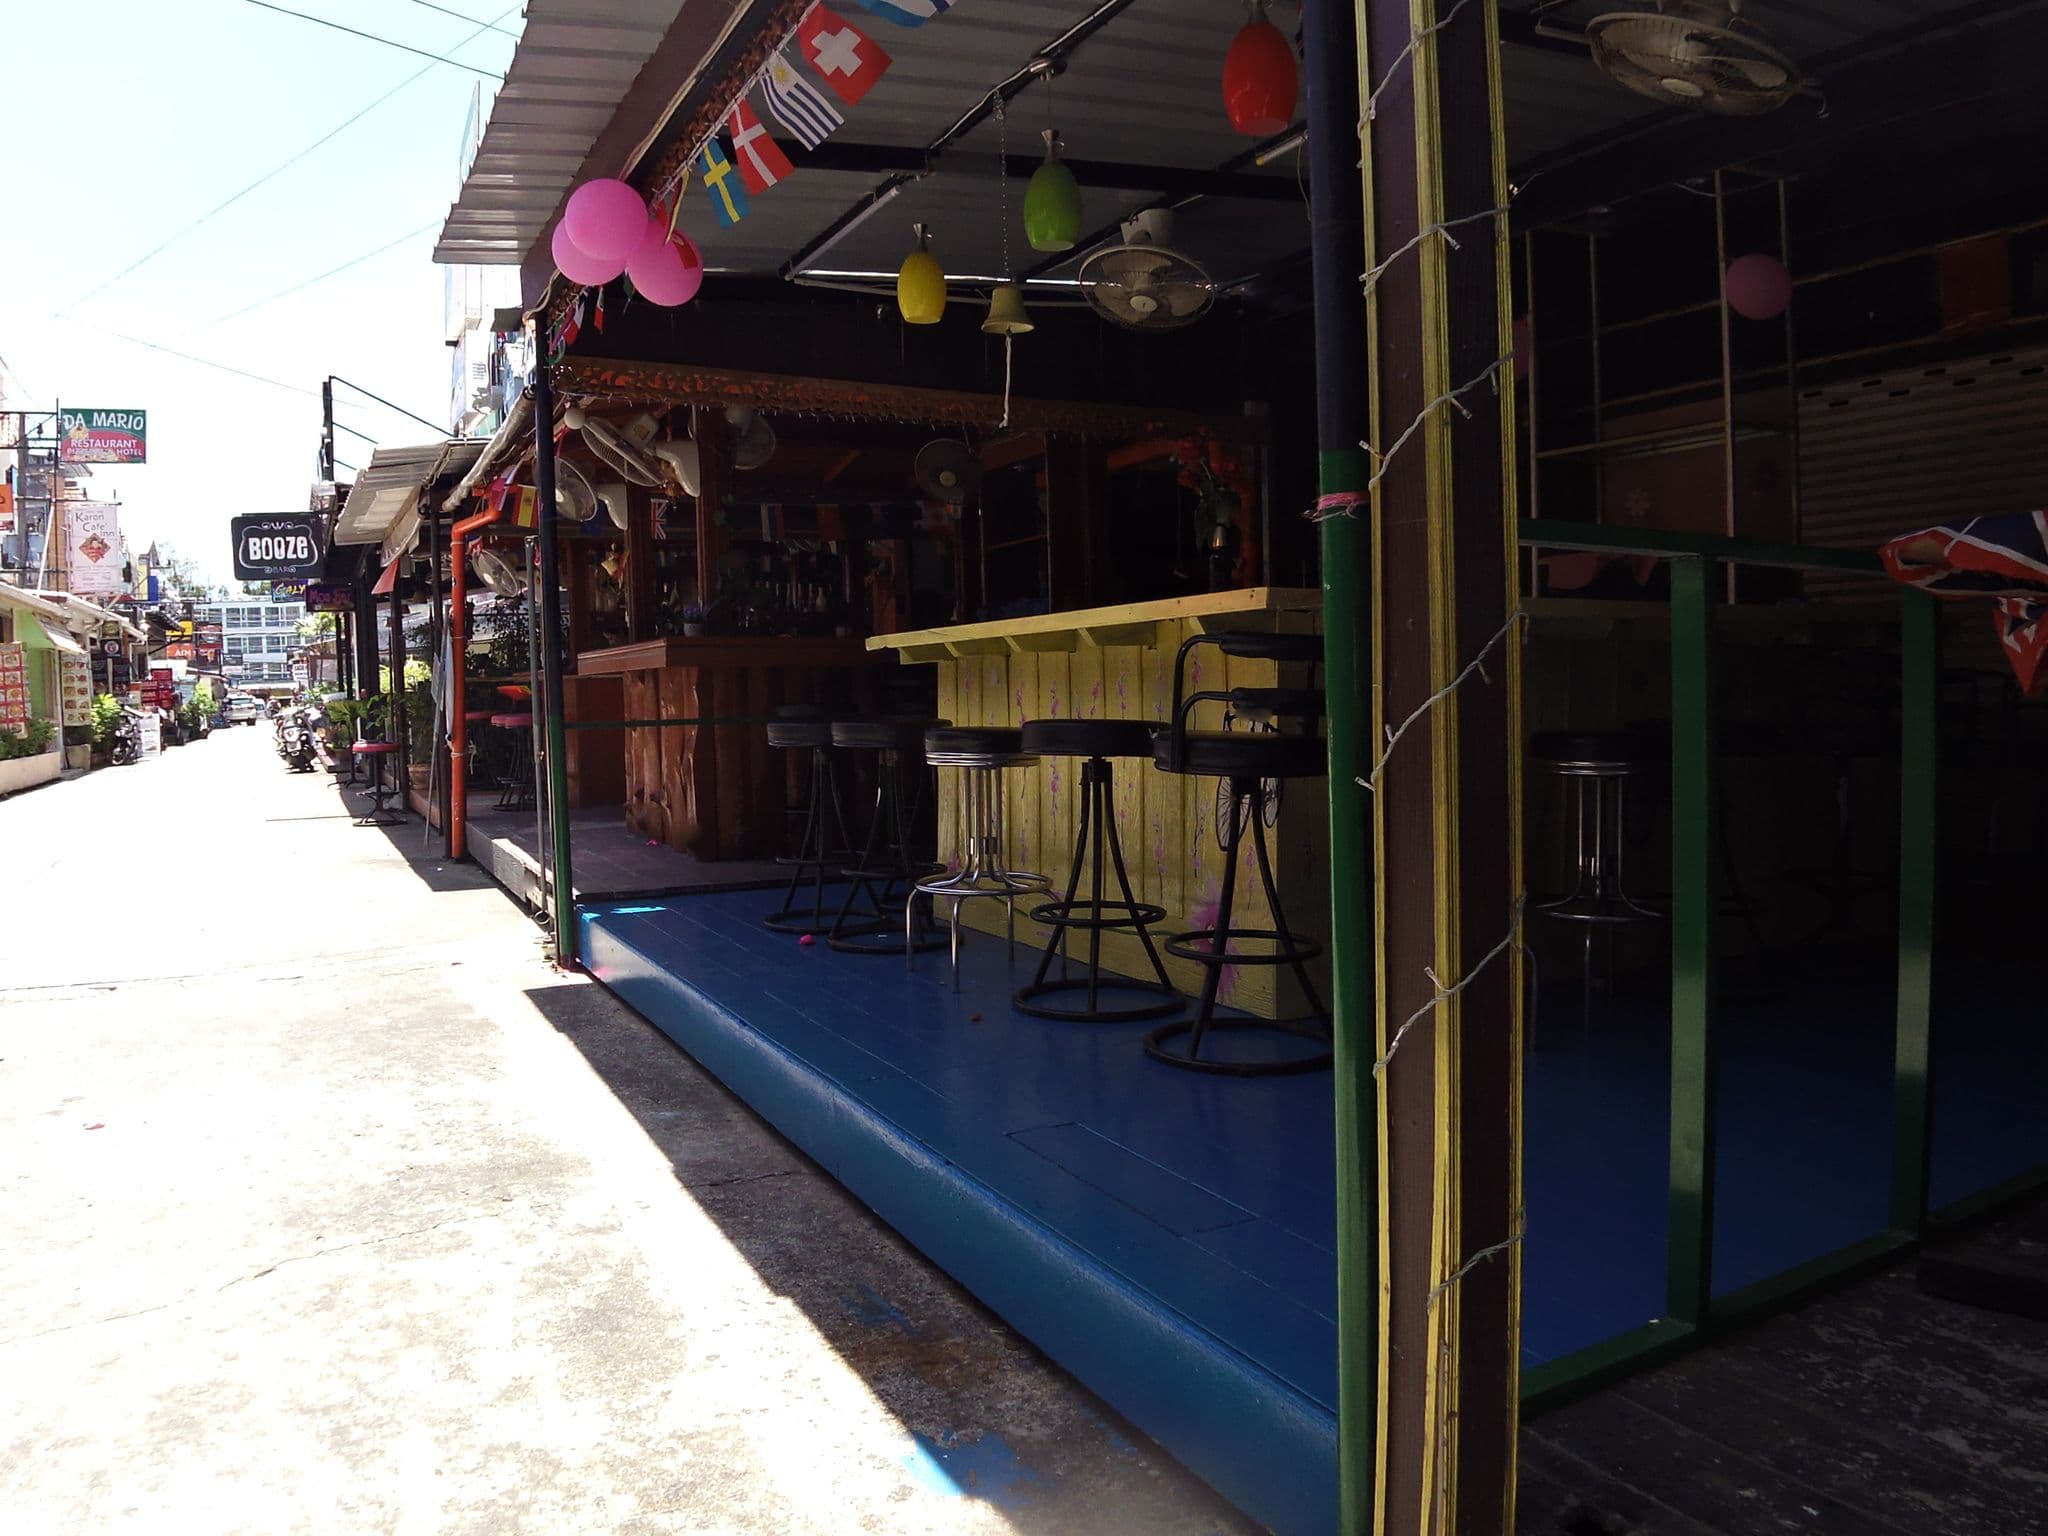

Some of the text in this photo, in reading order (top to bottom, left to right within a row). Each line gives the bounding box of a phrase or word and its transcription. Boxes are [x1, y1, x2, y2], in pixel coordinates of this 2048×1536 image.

[62, 411, 144, 431] DA MARIO
[70, 438, 138, 448] RESTAURANT
[116, 448, 143, 456] HOTEL
[75, 512, 105, 522] Karon
